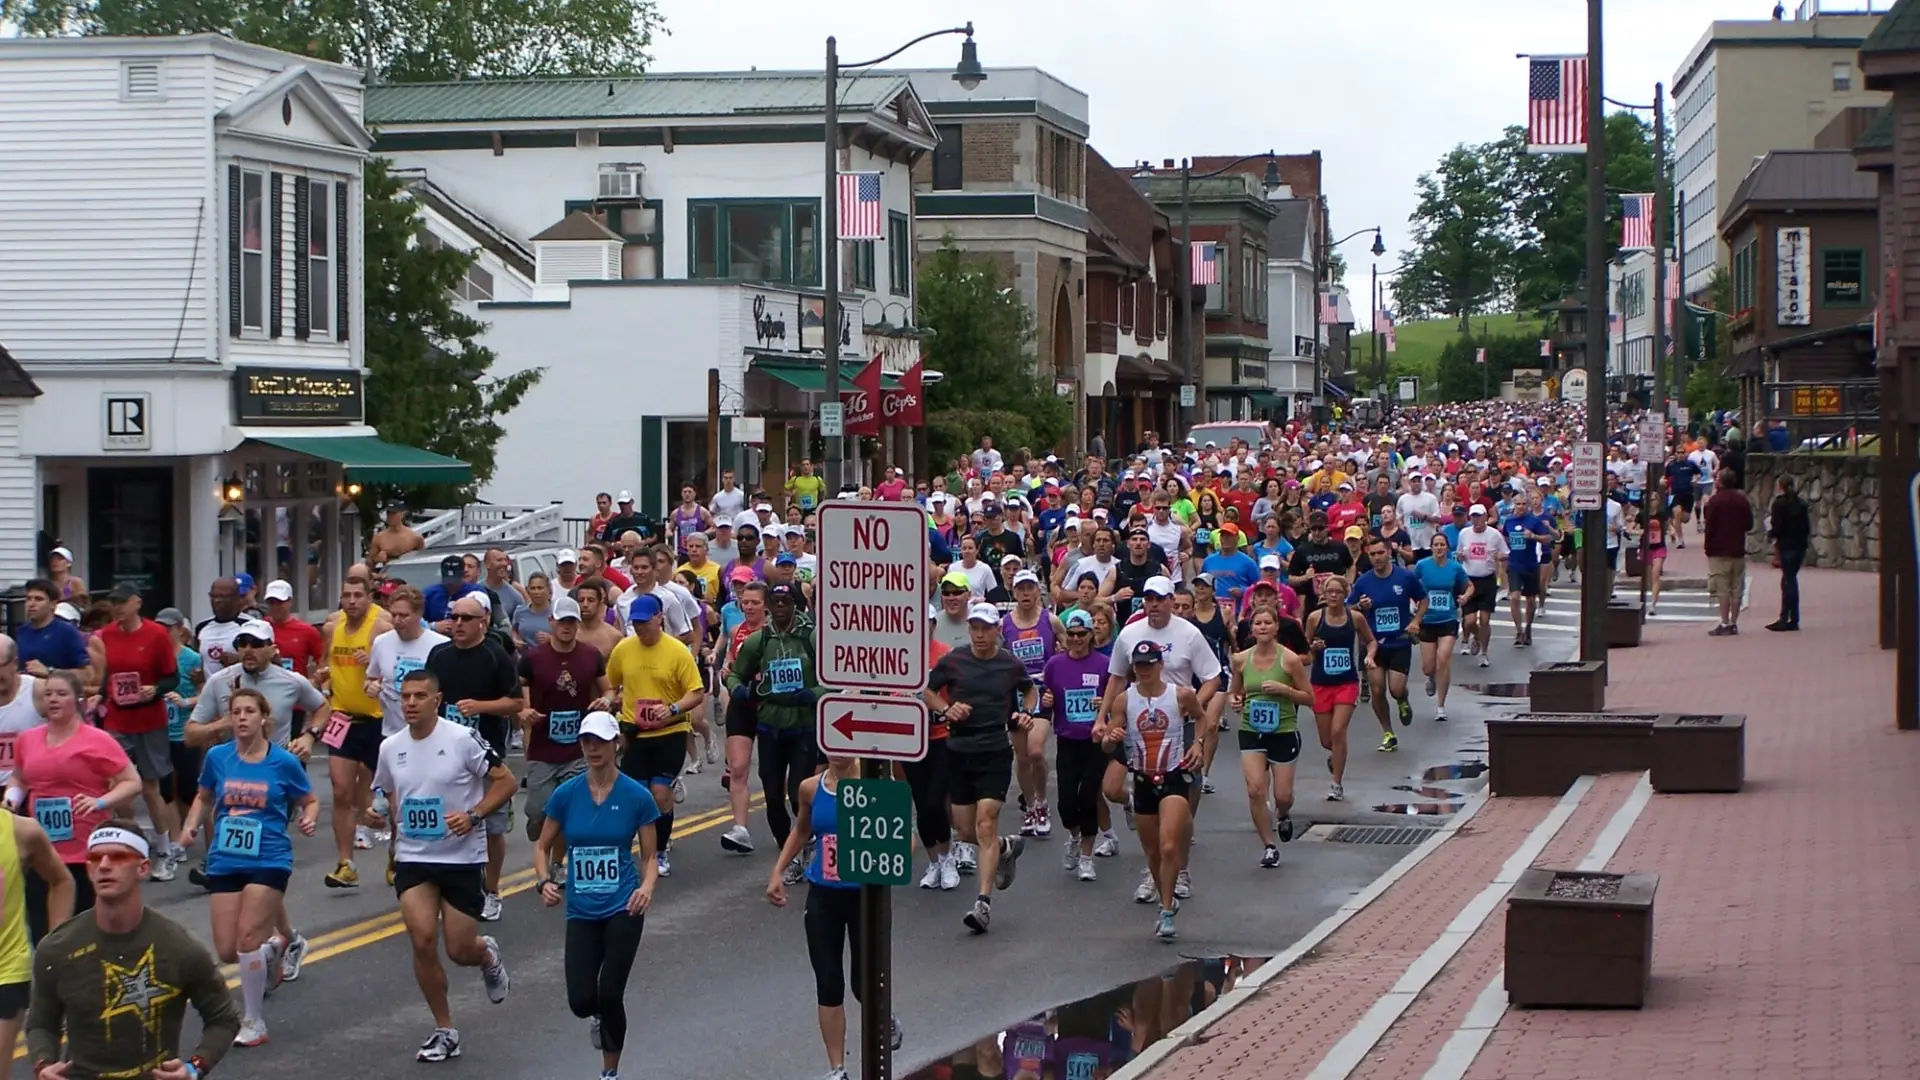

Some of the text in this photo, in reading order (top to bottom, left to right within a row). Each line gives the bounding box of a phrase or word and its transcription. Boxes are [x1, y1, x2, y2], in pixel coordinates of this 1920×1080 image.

[843, 391, 868, 414] 46
[1582, 446, 1593, 456] NO
[853, 517, 890, 551] NO
[829, 560, 915, 592] STOPPING
[829, 602, 914, 634] STANDING
[1376, 615, 1399, 626] 2008
[834, 644, 909, 676] PARKING
[1015, 645, 1043, 658] TEAM
[1325, 655, 1350, 668] 1508
[640, 707, 662, 722] 40
[1253, 709, 1275, 725] 951
[551, 719, 580, 735] 2459
[843, 785, 868, 808] 86
[35, 810, 71, 830] 1400
[408, 809, 438, 829] 999
[849, 816, 904, 840] 1202
[92, 831, 122, 841] ARMY
[225, 828, 254, 850] 750
[575, 859, 618, 881] 1046
